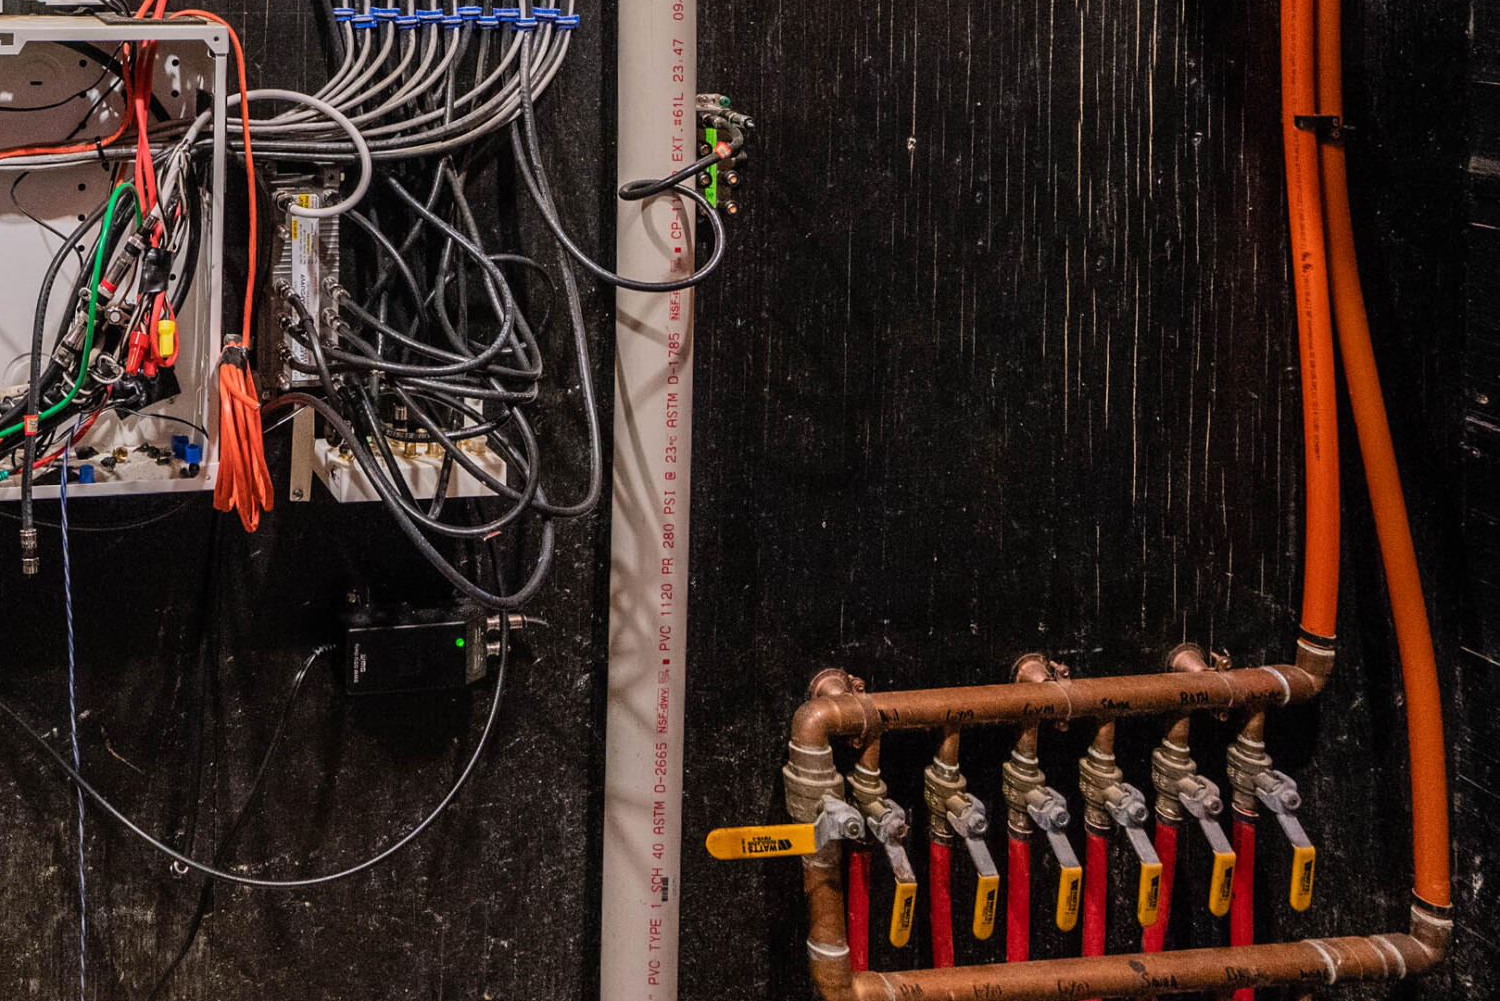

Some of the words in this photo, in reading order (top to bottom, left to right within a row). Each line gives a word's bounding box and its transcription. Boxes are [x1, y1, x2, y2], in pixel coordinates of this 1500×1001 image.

[672, 92, 685, 162] EXT.#61L
[667, 332, 680, 385] D-1785
[666, 392, 679, 428] ASTM
[663, 490, 676, 515] PSI
[662, 523, 675, 549] 280
[661, 557, 674, 575] PR
[660, 583, 673, 617] 1120
[658, 626, 672, 652] PVC
[654, 742, 668, 793] D-2665
[653, 800, 666, 835] ASTM
[652, 843, 665, 860] 40
[747, 842, 778, 853] WATTS
[650, 867, 664, 893] SCH
[649, 918, 662, 952] TYPE
[647, 960, 661, 986] PVC
